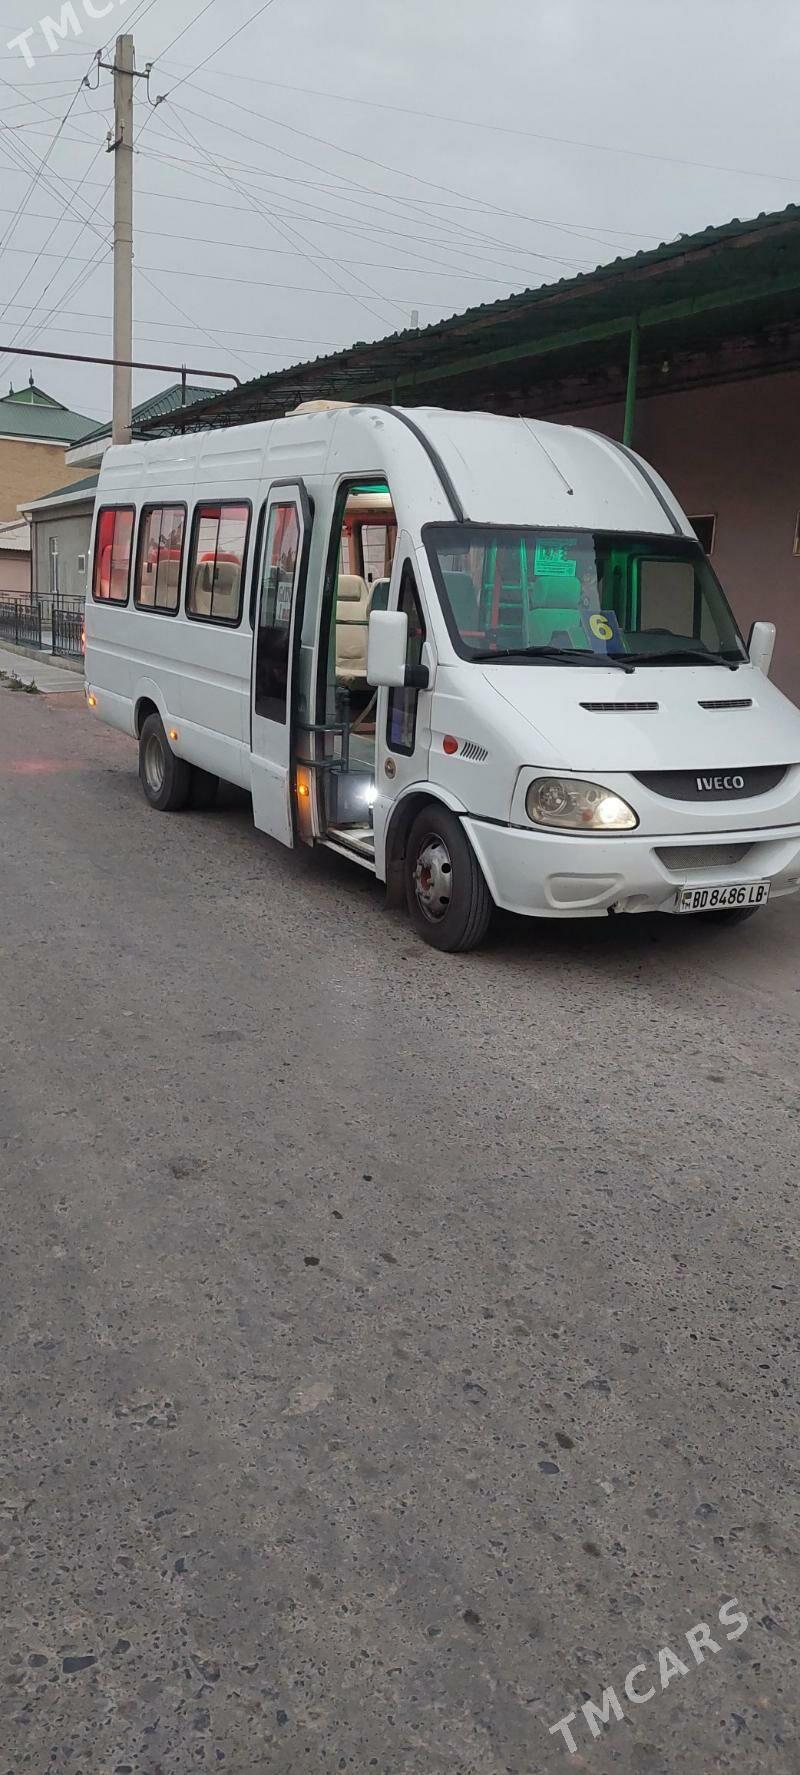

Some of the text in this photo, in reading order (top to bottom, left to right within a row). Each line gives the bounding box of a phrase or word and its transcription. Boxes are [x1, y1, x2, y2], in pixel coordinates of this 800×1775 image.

[589, 614, 613, 640] 6
[696, 775, 744, 791] IVECO
[709, 887, 746, 906] 8486
